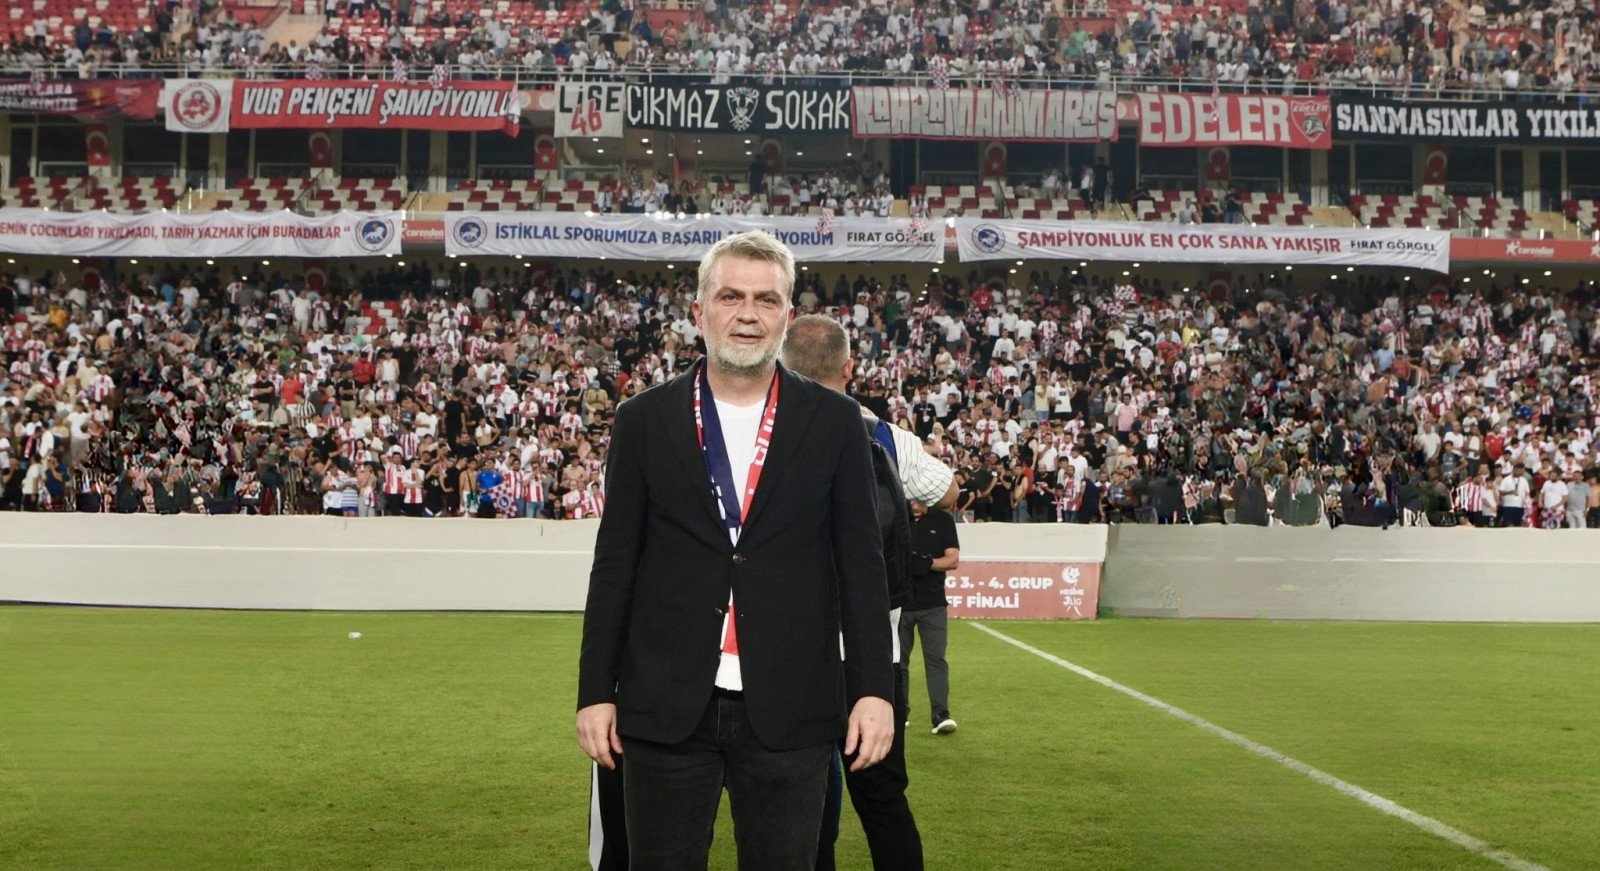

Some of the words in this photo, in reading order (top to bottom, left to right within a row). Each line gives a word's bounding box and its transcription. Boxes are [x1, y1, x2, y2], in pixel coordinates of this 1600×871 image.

[242, 87, 284, 115] VUR
[286, 84, 379, 124] PENÇENİ
[627, 85, 720, 129] ÇIKMAZ
[765, 90, 850, 130] SOKAK
[571, 98, 603, 136] 46
[1137, 93, 1291, 143] EDELER
[1336, 103, 1520, 138] SANMASINLAR
[162, 224, 195, 239] TARİH
[198, 225, 243, 239] YAZMAK
[246, 224, 269, 240] İÇİN
[273, 226, 341, 239] BURADALAR
[495, 222, 560, 240] İSTİKLAL
[564, 226, 657, 243] SPORUMUZA
[847, 232, 882, 242] FIRAT
[886, 229, 936, 243] GÖEL
[1017, 230, 1145, 249] ŞAMPİYONLUK
[1151, 234, 1173, 248] EN
[1178, 234, 1214, 250] ÇOK
[1219, 235, 1268, 250] SANA
[1272, 237, 1341, 254] YAKIŞIR
[1350, 240, 1384, 250] FIRAT
[960, 576, 975, 589] 3.
[988, 576, 1005, 589] 4.
[1008, 577, 1054, 590] GRUP
[966, 592, 1020, 608] FİNALİ
